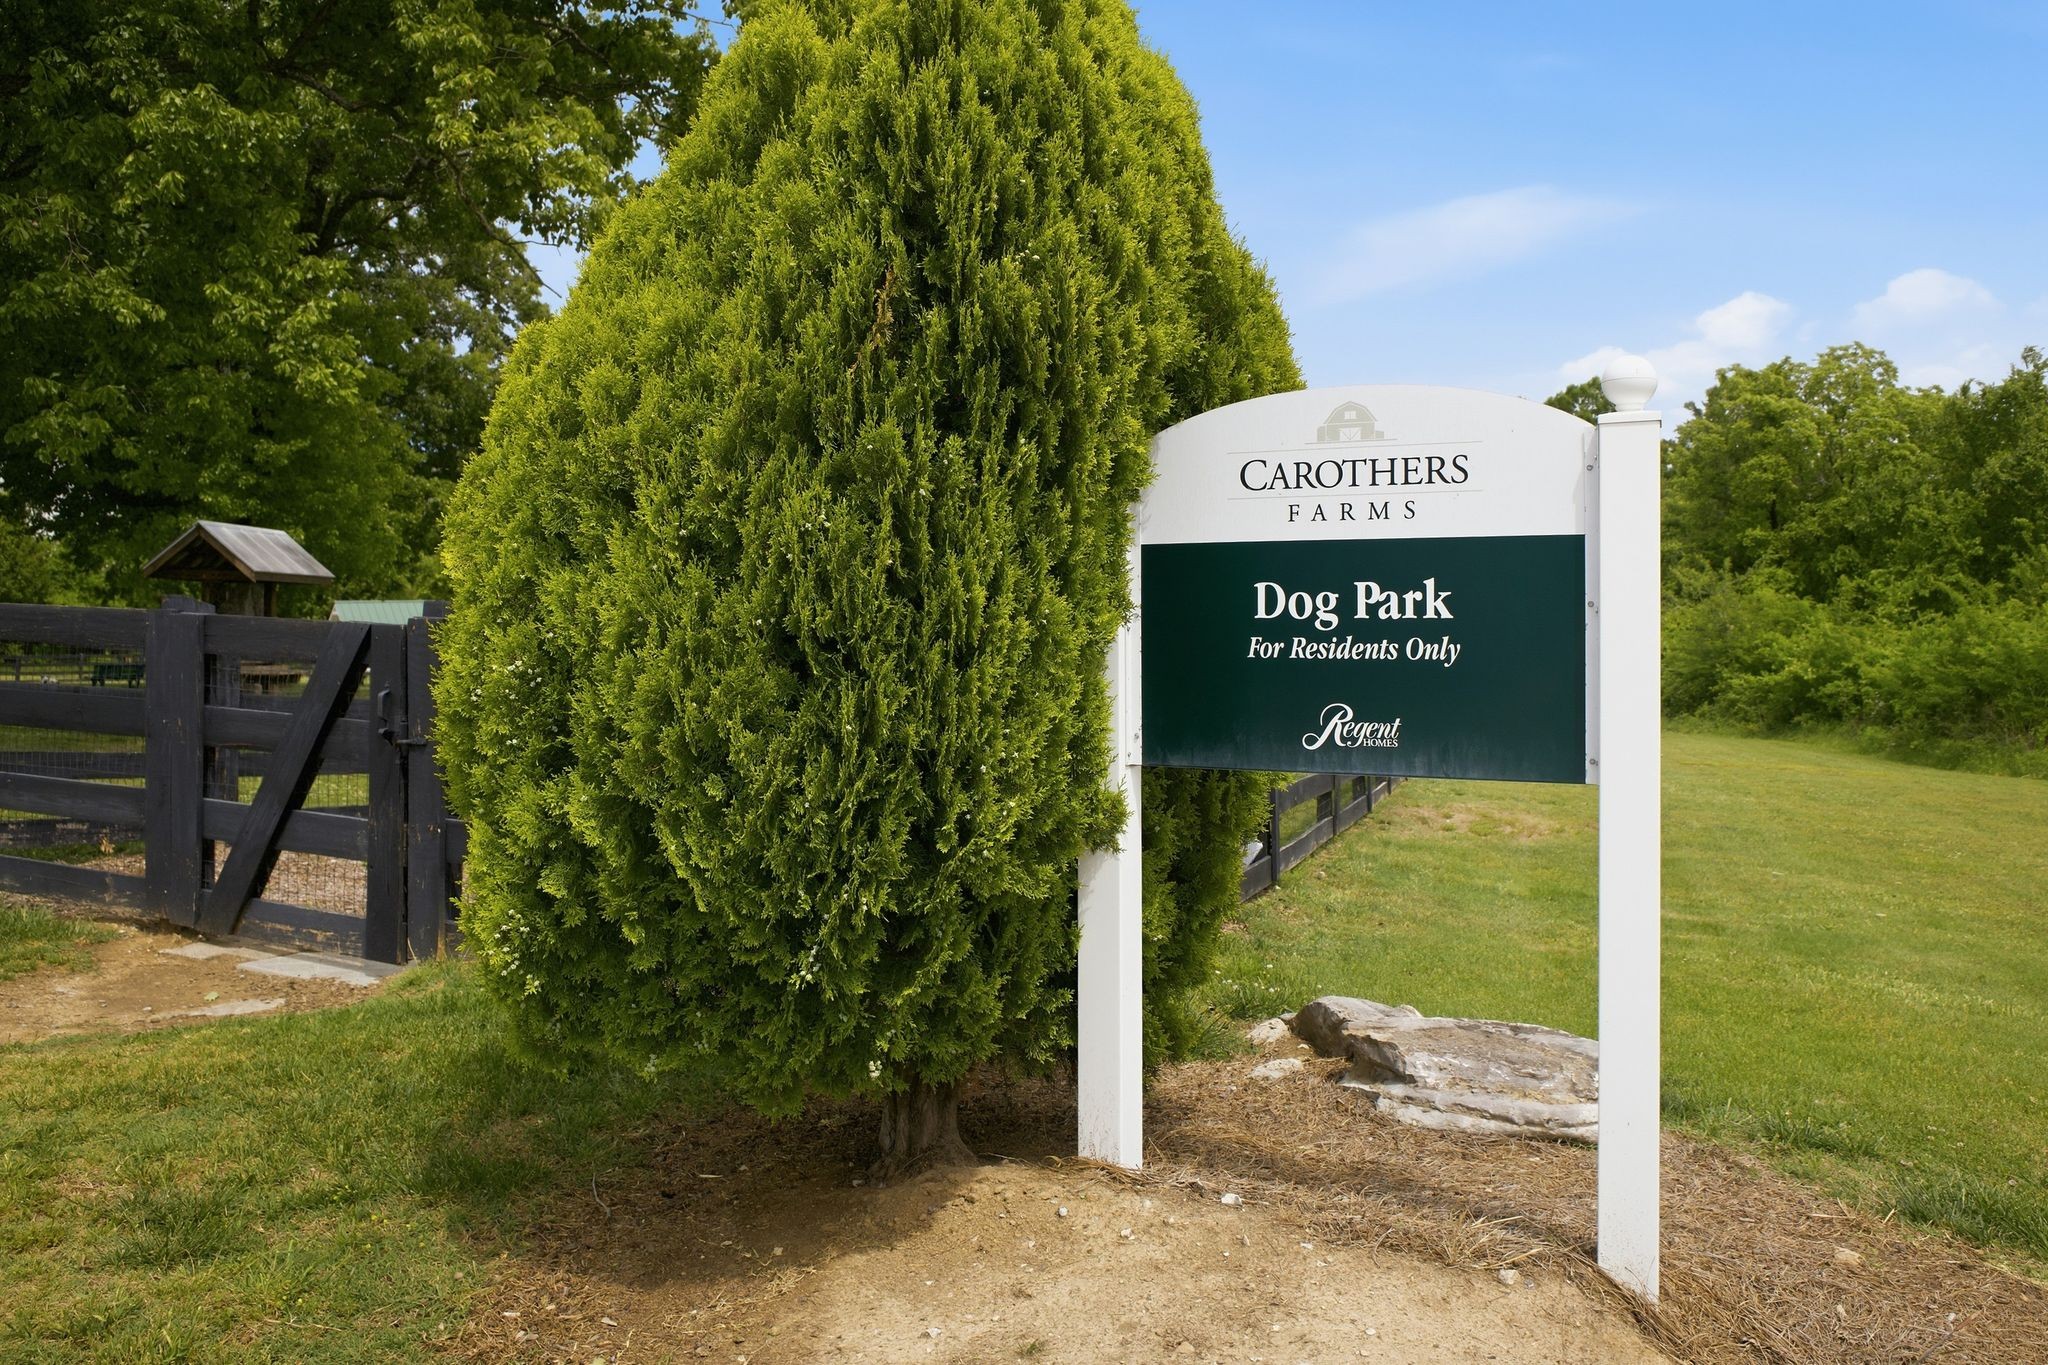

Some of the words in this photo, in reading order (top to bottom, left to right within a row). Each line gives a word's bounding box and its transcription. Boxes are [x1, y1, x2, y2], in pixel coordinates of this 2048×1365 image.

[1239, 454, 1469, 492] CAROTHERS
[1287, 500, 1416, 523] FARMS
[1253, 581, 1340, 632] Dog
[1353, 577, 1454, 620] Park
[1247, 636, 1285, 659] For
[1289, 635, 1399, 660] Residents
[1405, 635, 1461, 668] Only
[1302, 702, 1402, 751] Regent
[1362, 737, 1399, 748] HOMES
